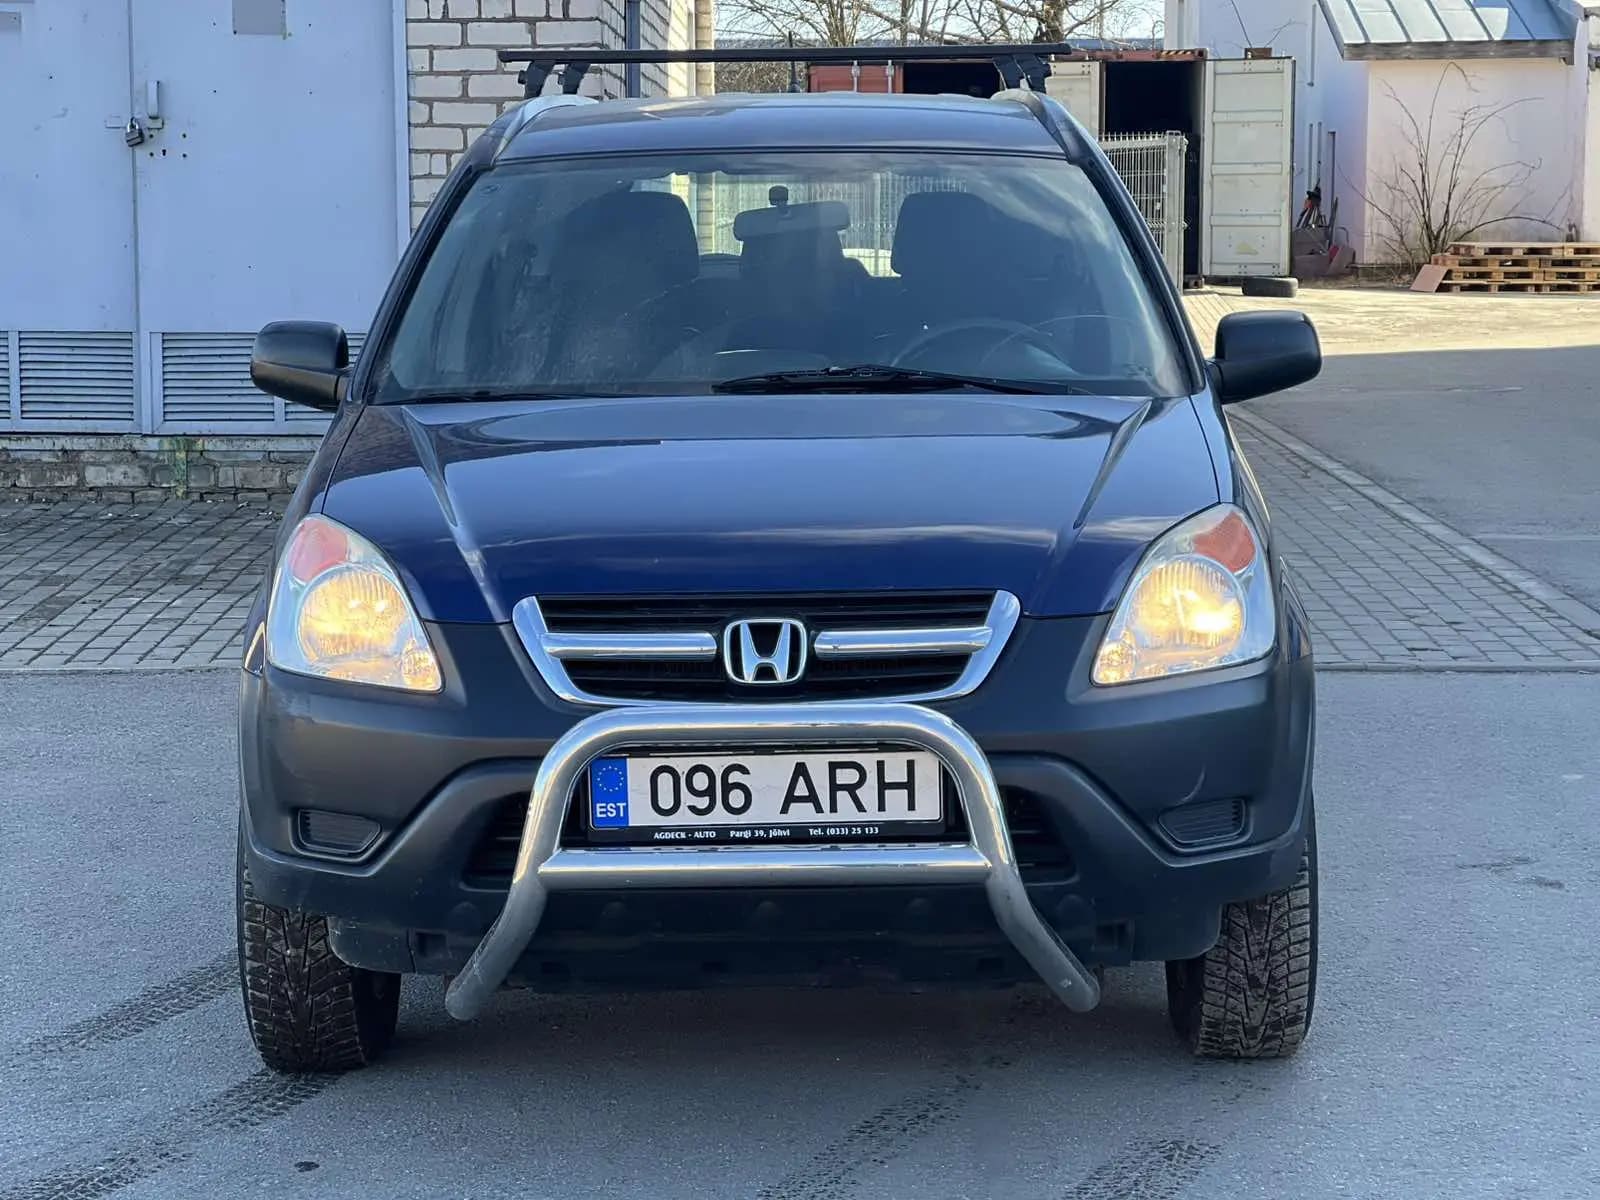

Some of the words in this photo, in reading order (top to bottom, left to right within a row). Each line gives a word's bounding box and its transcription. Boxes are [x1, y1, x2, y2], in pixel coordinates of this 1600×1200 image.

[650, 763, 753, 816] 096
[779, 759, 916, 814] ARH
[596, 803, 626, 817] EST
[754, 830, 767, 838] 39,
[809, 828, 824, 836] Tel.
[826, 827, 849, 836] (033)
[852, 827, 862, 835] 25
[865, 826, 879, 835] 133
